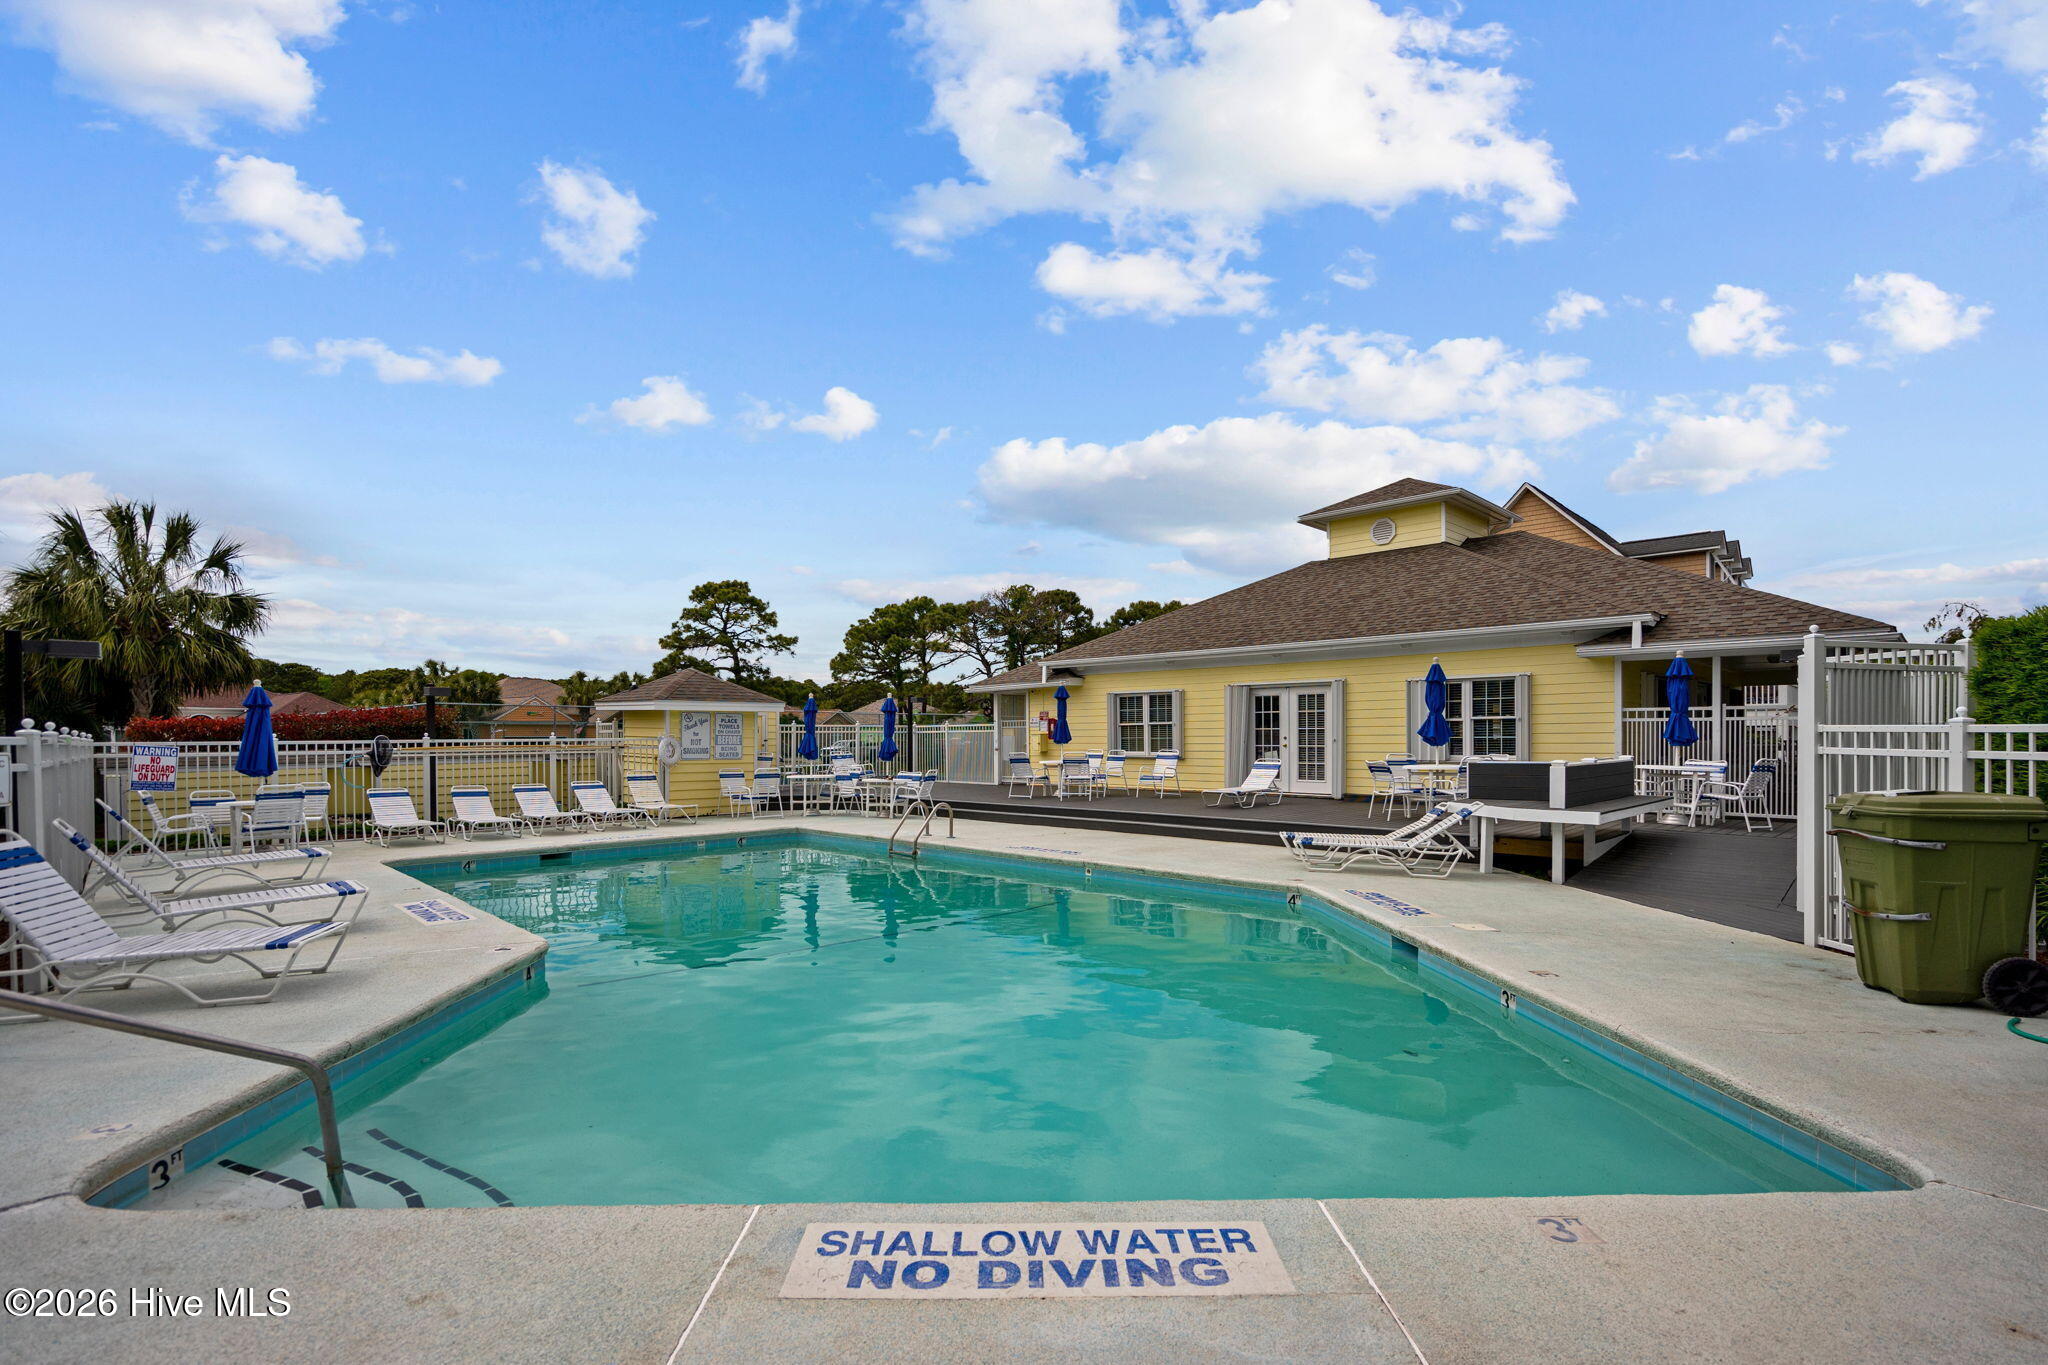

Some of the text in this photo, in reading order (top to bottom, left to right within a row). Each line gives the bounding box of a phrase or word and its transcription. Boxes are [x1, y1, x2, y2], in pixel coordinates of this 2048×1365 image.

[690, 738, 702, 746] NOT
[717, 736, 742, 744] BEFORE
[135, 746, 177, 757] WARNING
[682, 747, 709, 755] SMOKING
[150, 756, 161, 765] NO
[133, 764, 175, 773] LIFEGUARD
[150, 773, 171, 781] DUTY
[816, 1228, 1258, 1257] SHALLOW WATER
[846, 1257, 1231, 1290] NO DIVING
